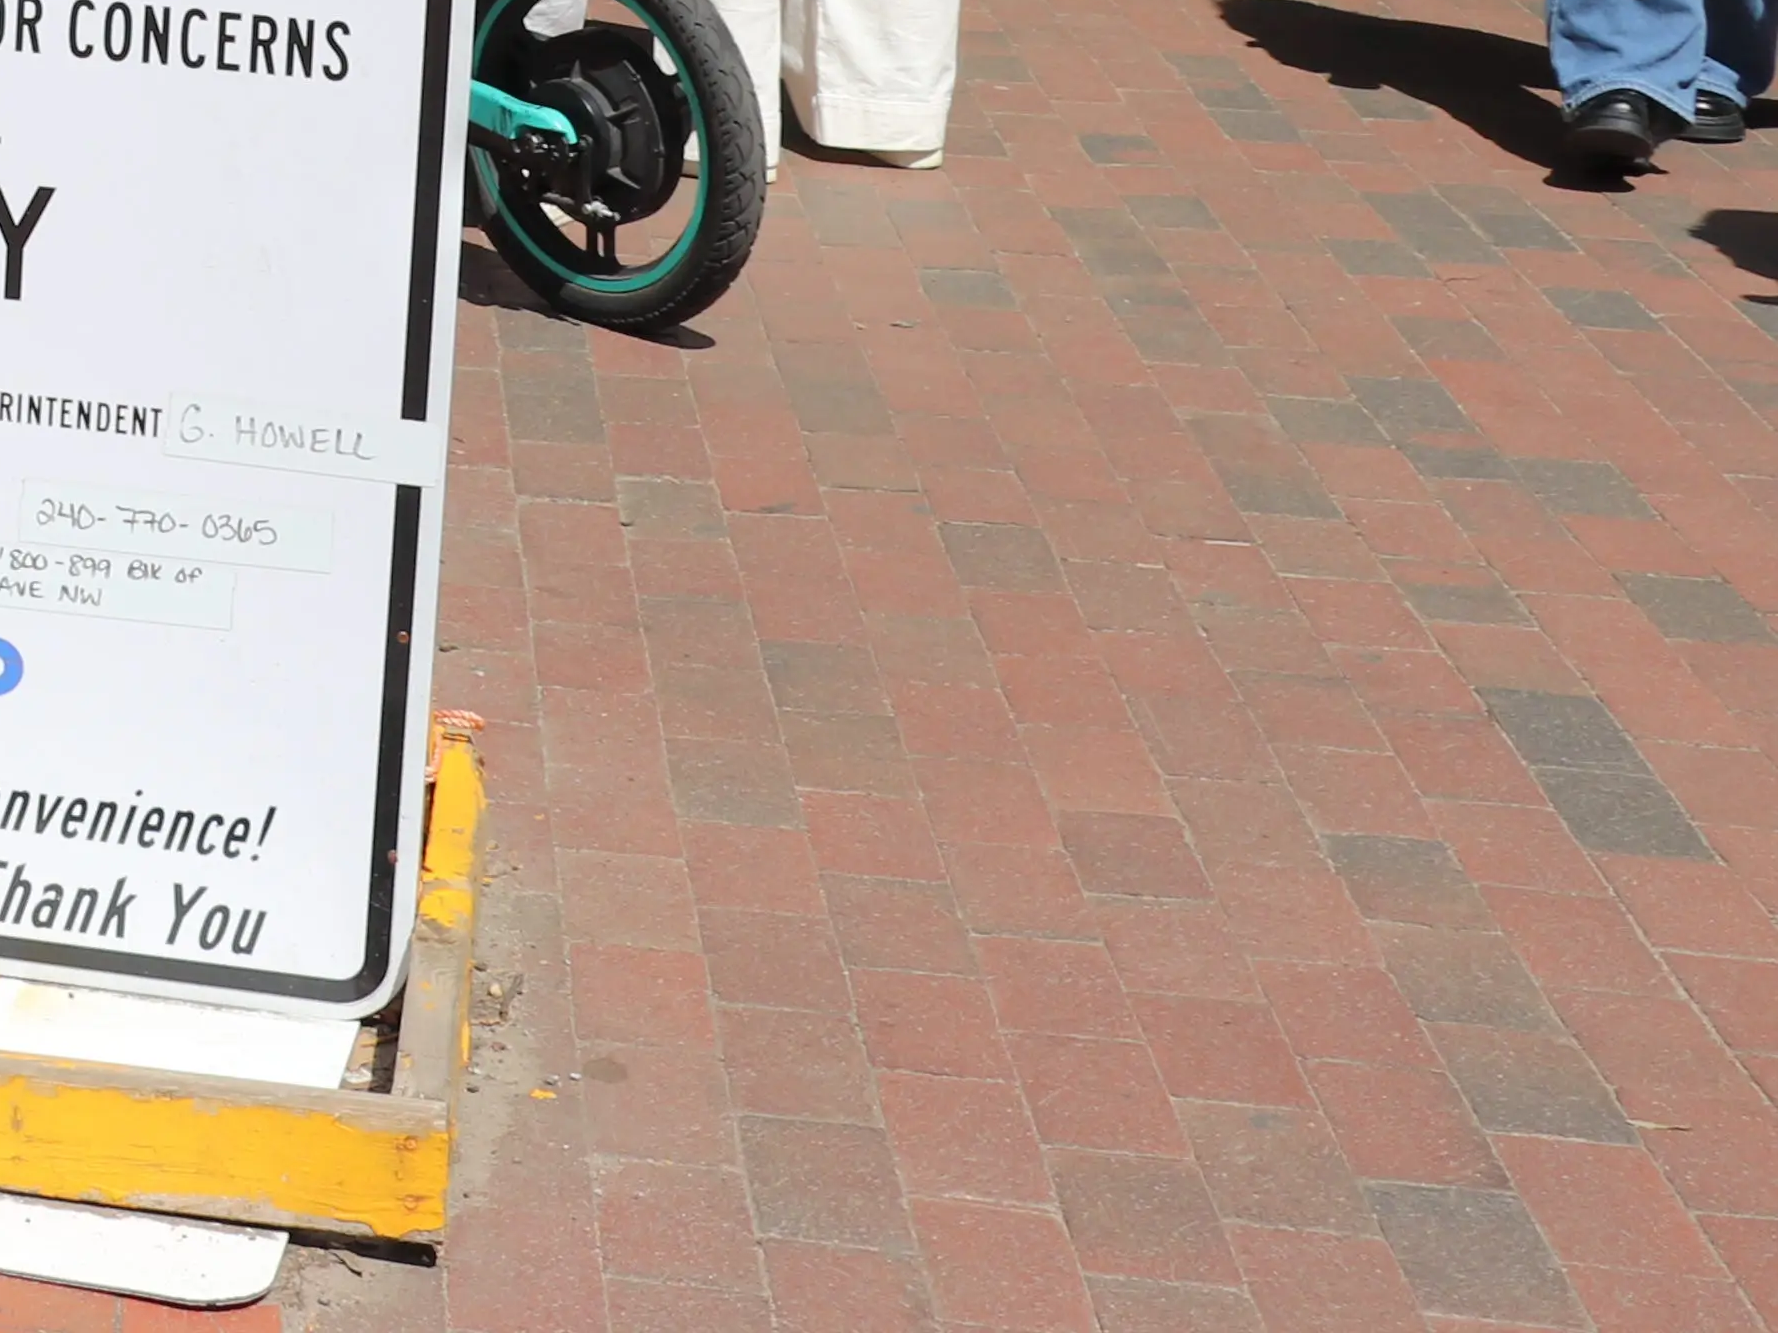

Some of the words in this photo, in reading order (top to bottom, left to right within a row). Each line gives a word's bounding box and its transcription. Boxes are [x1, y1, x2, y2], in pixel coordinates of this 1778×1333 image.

[180, 404, 214, 443] G.
[236, 416, 375, 468] HOWELL
[36, 498, 277, 545] 240-770-0365
[165, 883, 267, 955] You
